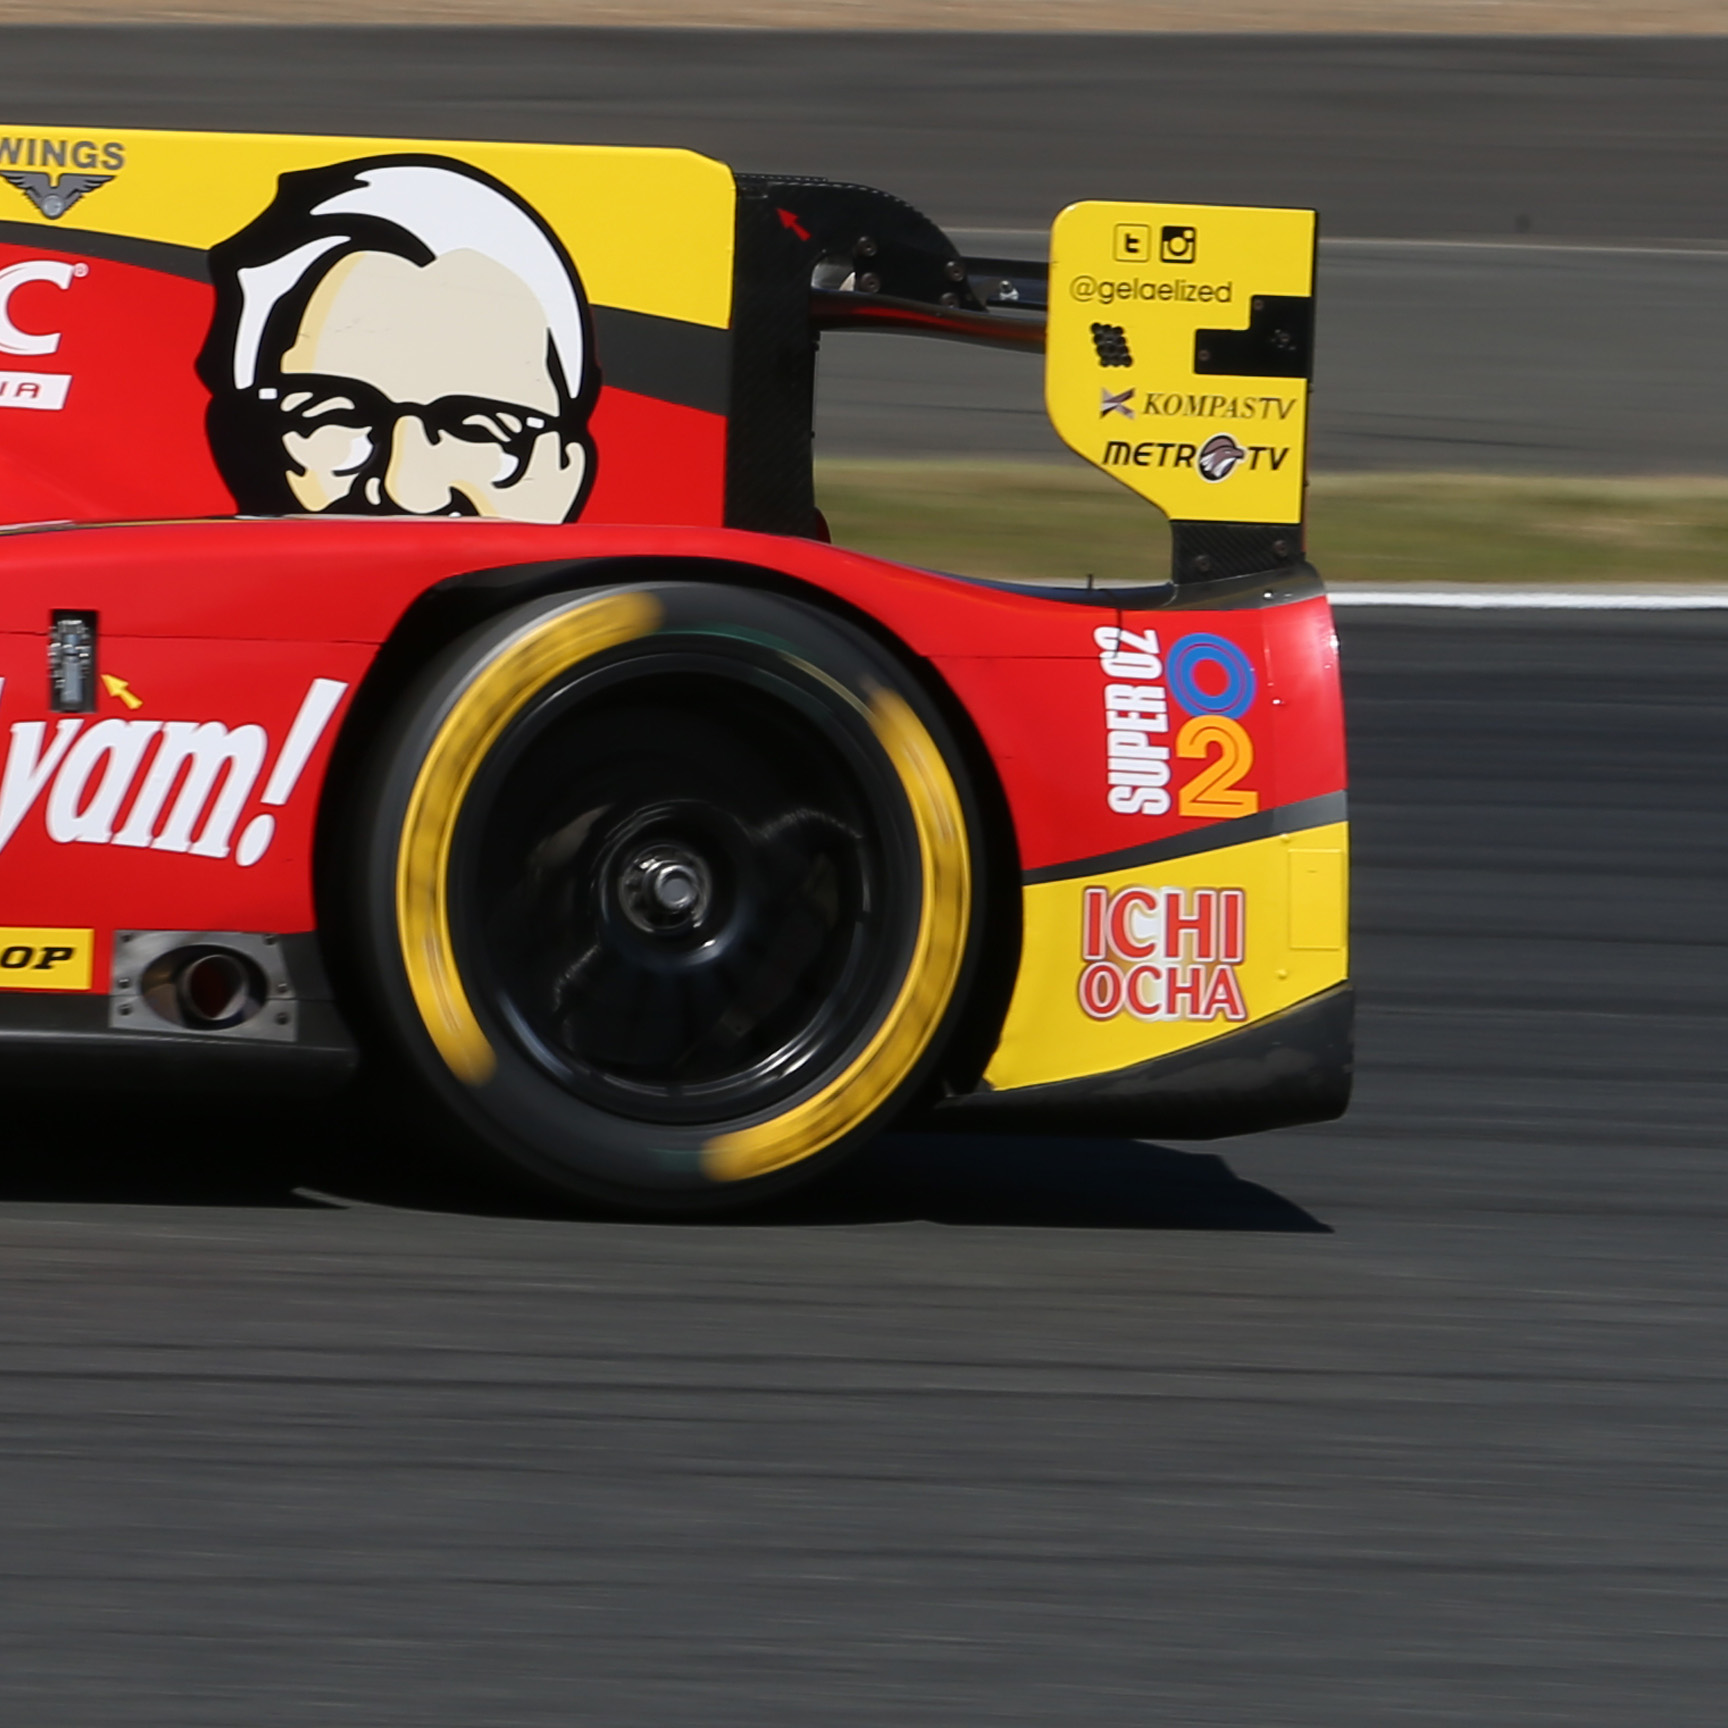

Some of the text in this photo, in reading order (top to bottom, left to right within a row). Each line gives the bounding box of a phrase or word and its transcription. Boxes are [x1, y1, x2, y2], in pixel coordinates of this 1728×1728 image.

[1069, 275, 1233, 305] @gelaelized
[1102, 684, 1171, 815] SUPER
[1083, 887, 1246, 963] ICHI
[1078, 962, 1249, 1022] OCHA
